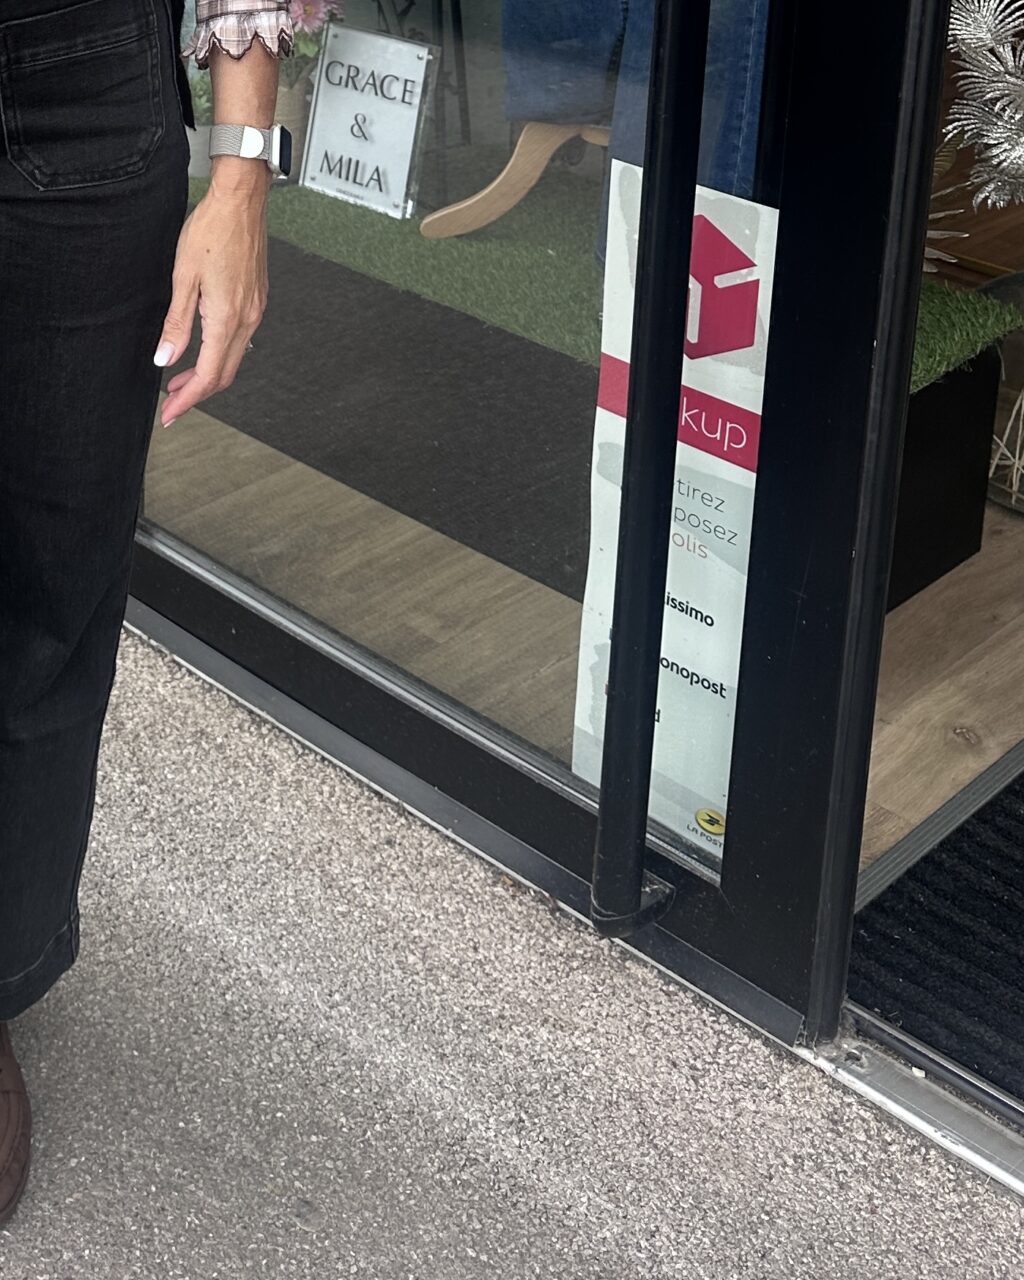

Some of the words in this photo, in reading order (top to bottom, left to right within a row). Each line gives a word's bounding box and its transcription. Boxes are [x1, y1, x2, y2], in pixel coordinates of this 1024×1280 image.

[324, 60, 415, 105] GRACE
[350, 112, 368, 141] &
[319, 149, 384, 193] MILA
[681, 396, 747, 451] kup
[676, 478, 726, 513] tirez
[673, 506, 739, 546] posez
[671, 532, 708, 559] olis
[664, 592, 715, 627] issimo
[659, 656, 727, 699] onopost
[686, 822, 700, 837] LA
[700, 829, 724, 849] POST
